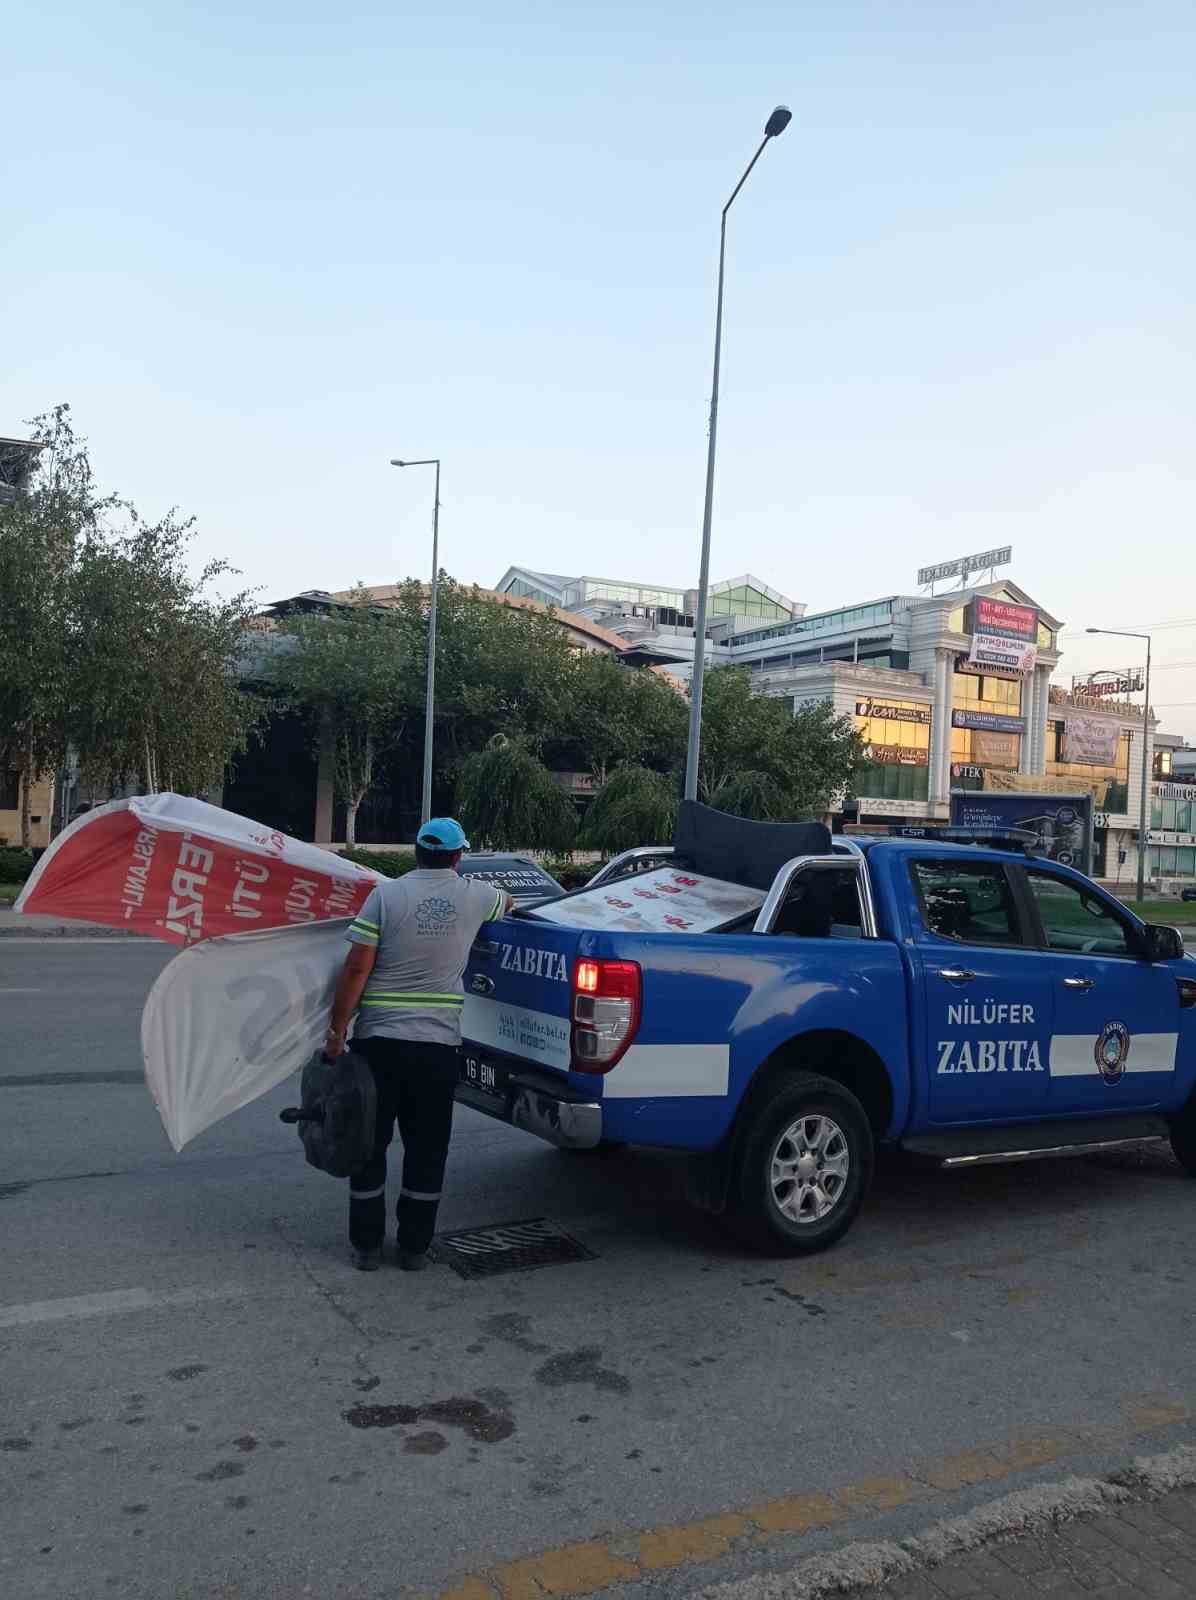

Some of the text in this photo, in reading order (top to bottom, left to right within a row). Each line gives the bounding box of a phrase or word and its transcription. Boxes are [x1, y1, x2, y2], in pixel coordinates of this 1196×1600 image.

[501, 943, 568, 982] ZABITA
[948, 999, 1035, 1025] NİLÜFER
[937, 1041, 1044, 1074] ZABITA
